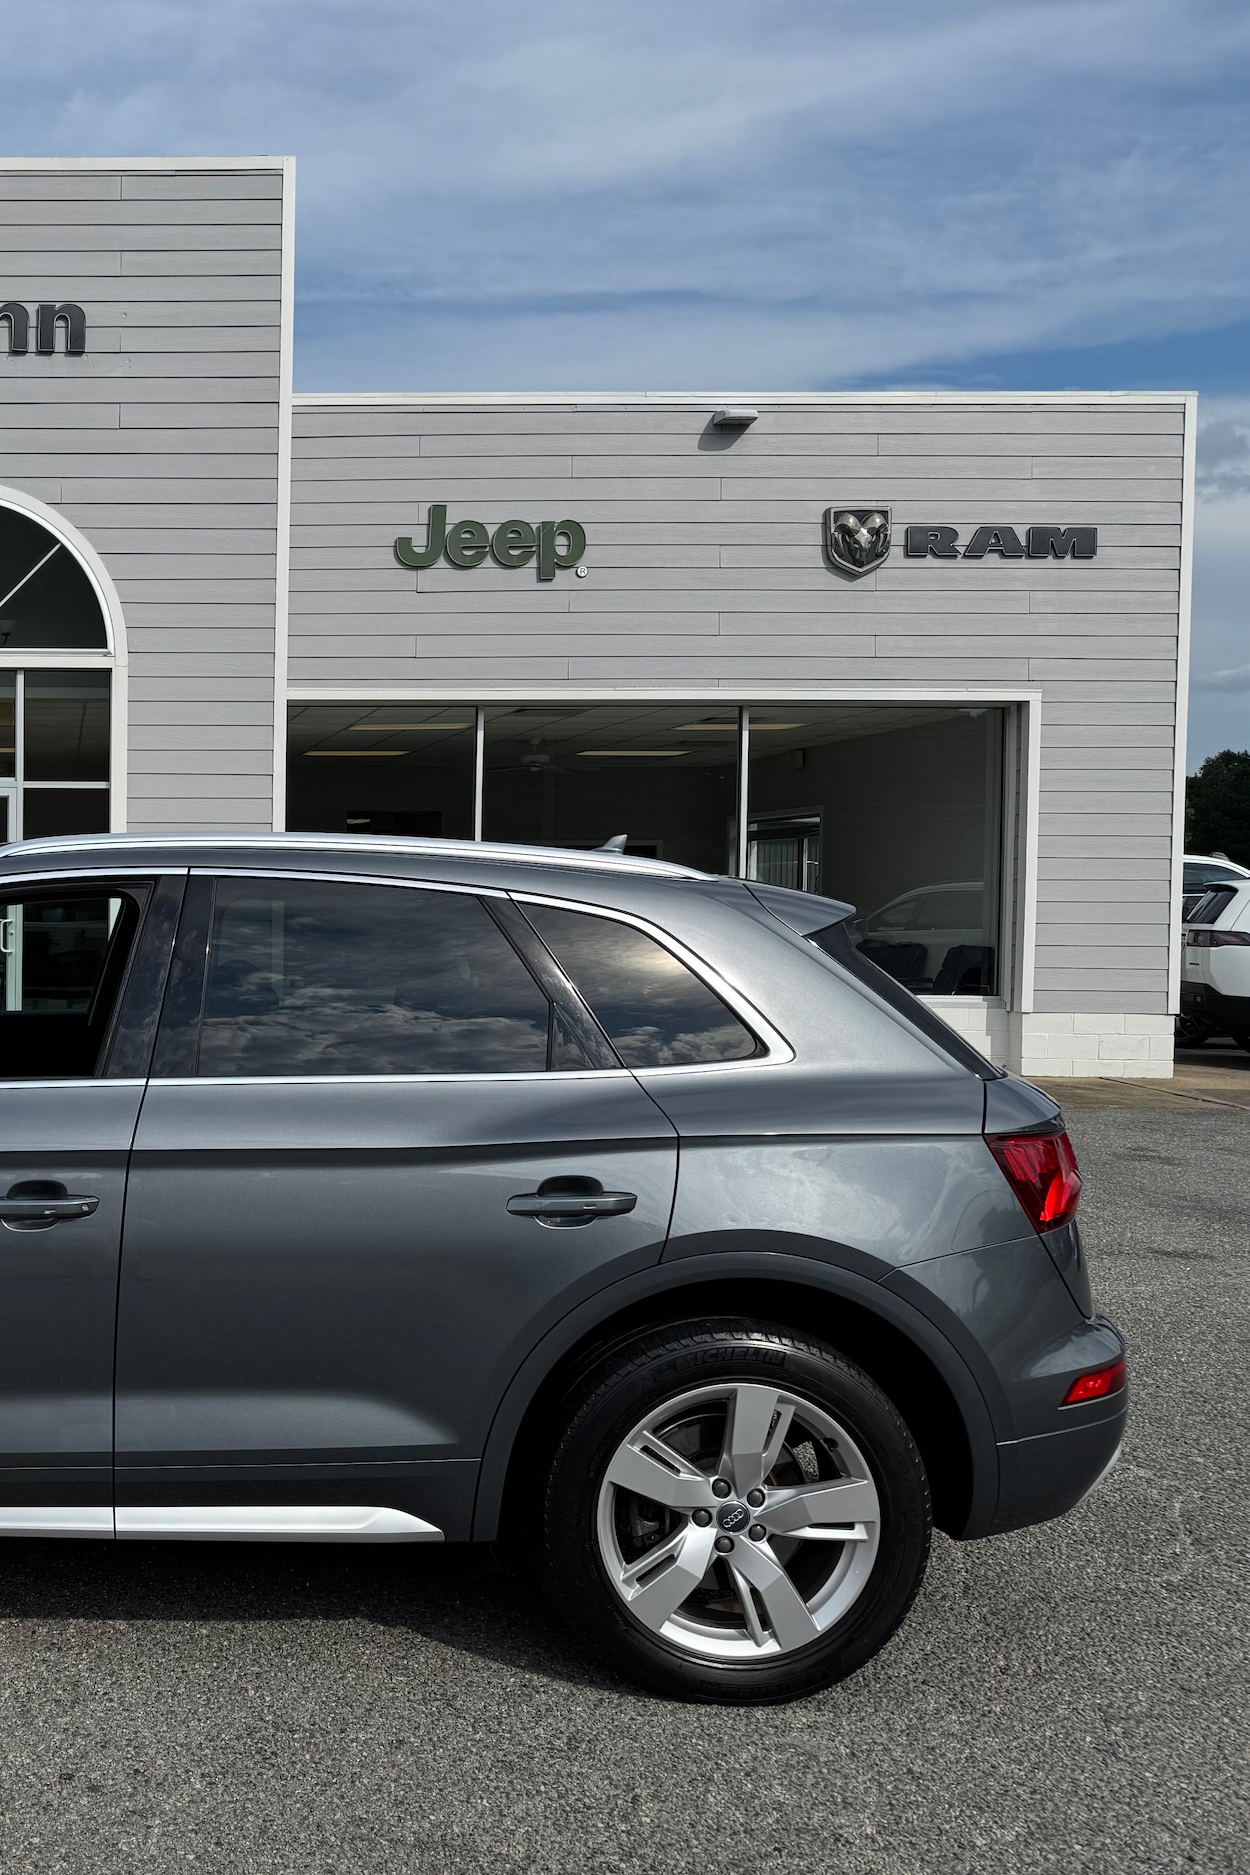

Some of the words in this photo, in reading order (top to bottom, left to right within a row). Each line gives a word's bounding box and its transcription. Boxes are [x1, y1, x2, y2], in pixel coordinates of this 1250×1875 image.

[396, 504, 586, 580] Jeep
[906, 526, 1098, 557] RAM
[676, 1347, 786, 1371] MICHELIN
